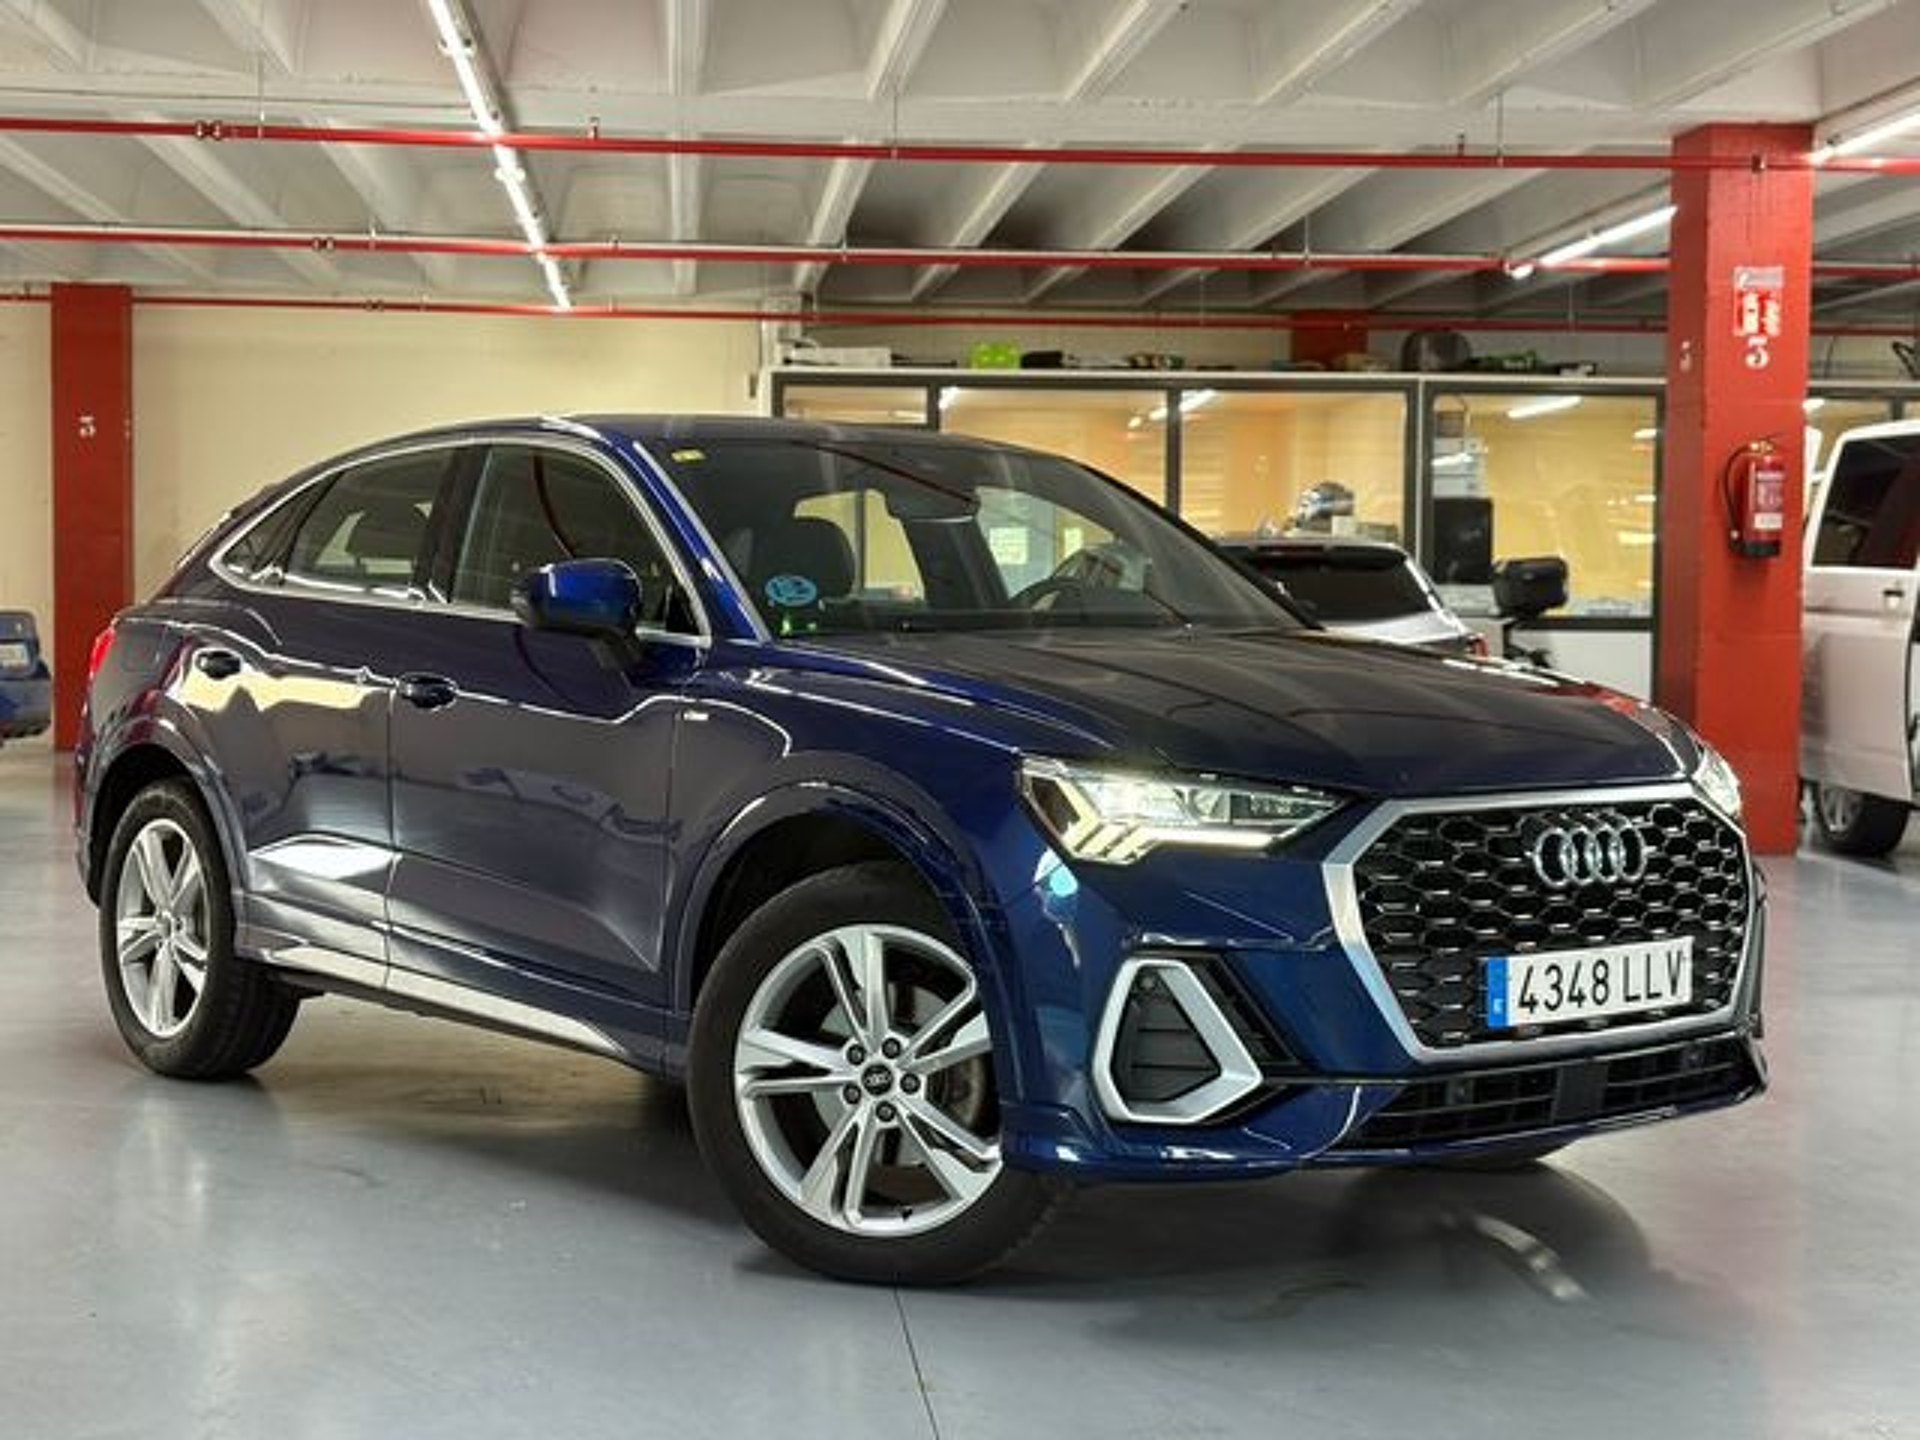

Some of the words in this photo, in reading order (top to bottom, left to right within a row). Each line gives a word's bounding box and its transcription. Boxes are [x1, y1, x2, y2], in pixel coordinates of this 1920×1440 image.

[1745, 336, 1769, 369] 5
[1517, 958, 1610, 1014] 4348
[1622, 950, 1682, 1002] LLV
